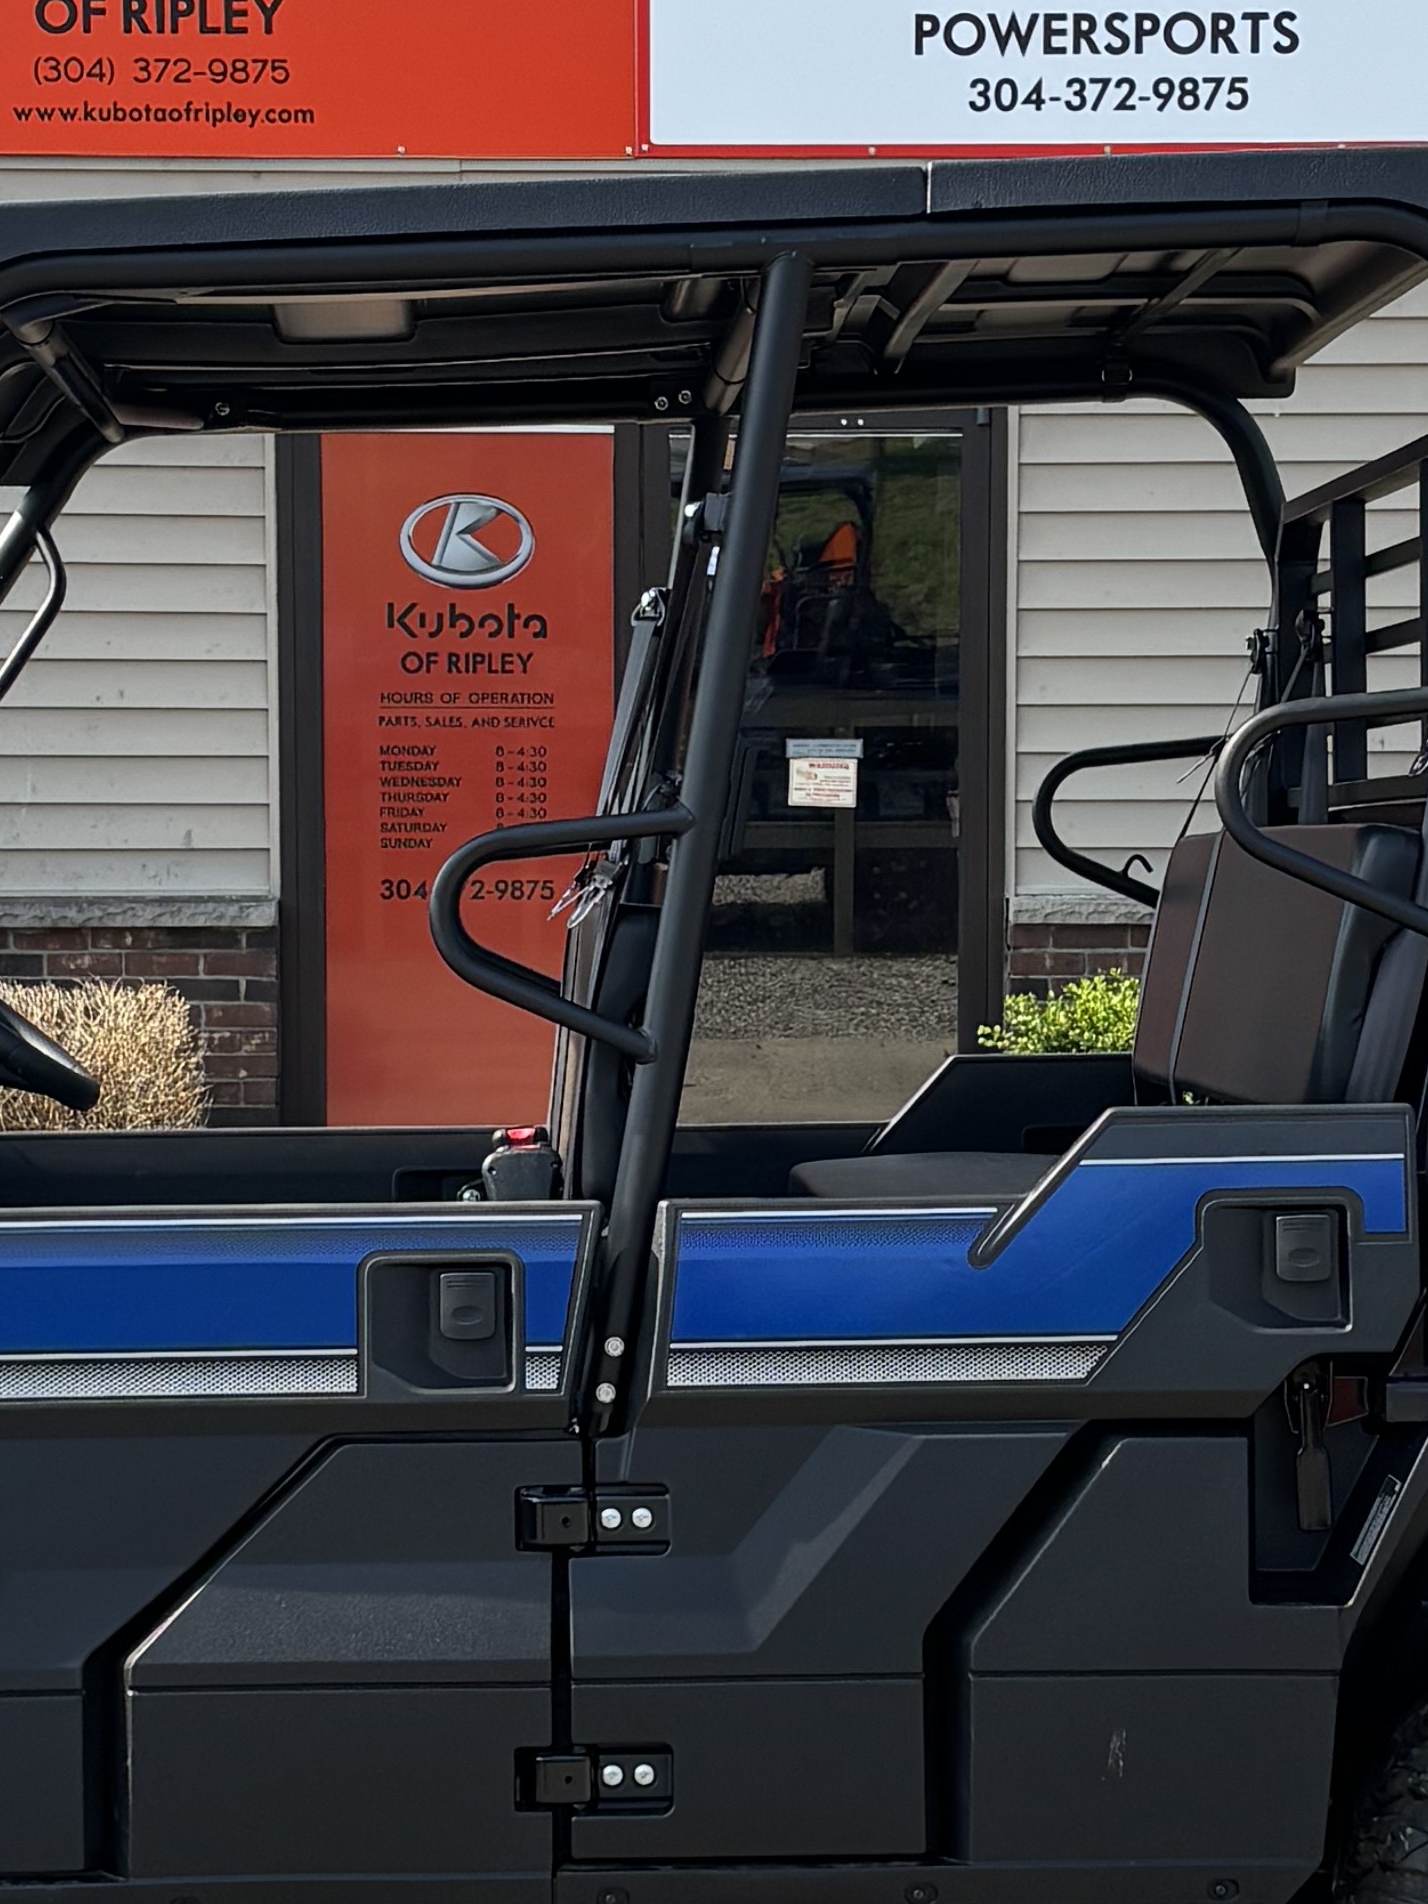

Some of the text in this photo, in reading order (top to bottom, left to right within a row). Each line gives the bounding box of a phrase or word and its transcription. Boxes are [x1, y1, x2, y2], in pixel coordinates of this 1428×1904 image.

[914, 10, 1301, 58] POWERSPORTS
[33, 56, 291, 86] (304) 372-9875
[967, 76, 1250, 113] 304-372-9875
[12, 100, 316, 128] www.kubotaofripley.com
[386, 601, 548, 639] Kubota
[400, 651, 534, 674] OF RIPLEY
[379, 692, 555, 705] HOURS OF OPERATION
[471, 716, 501, 729] AND
[379, 745, 437, 757] MONDAY
[379, 761, 440, 772] TUESDAY
[379, 777, 462, 788] WEDNESDAY
[379, 792, 450, 803] THURSDAY
[379, 807, 425, 818] FRIDAY
[379, 822, 448, 834] SATURDAY
[379, 838, 433, 849] SUNDAY
